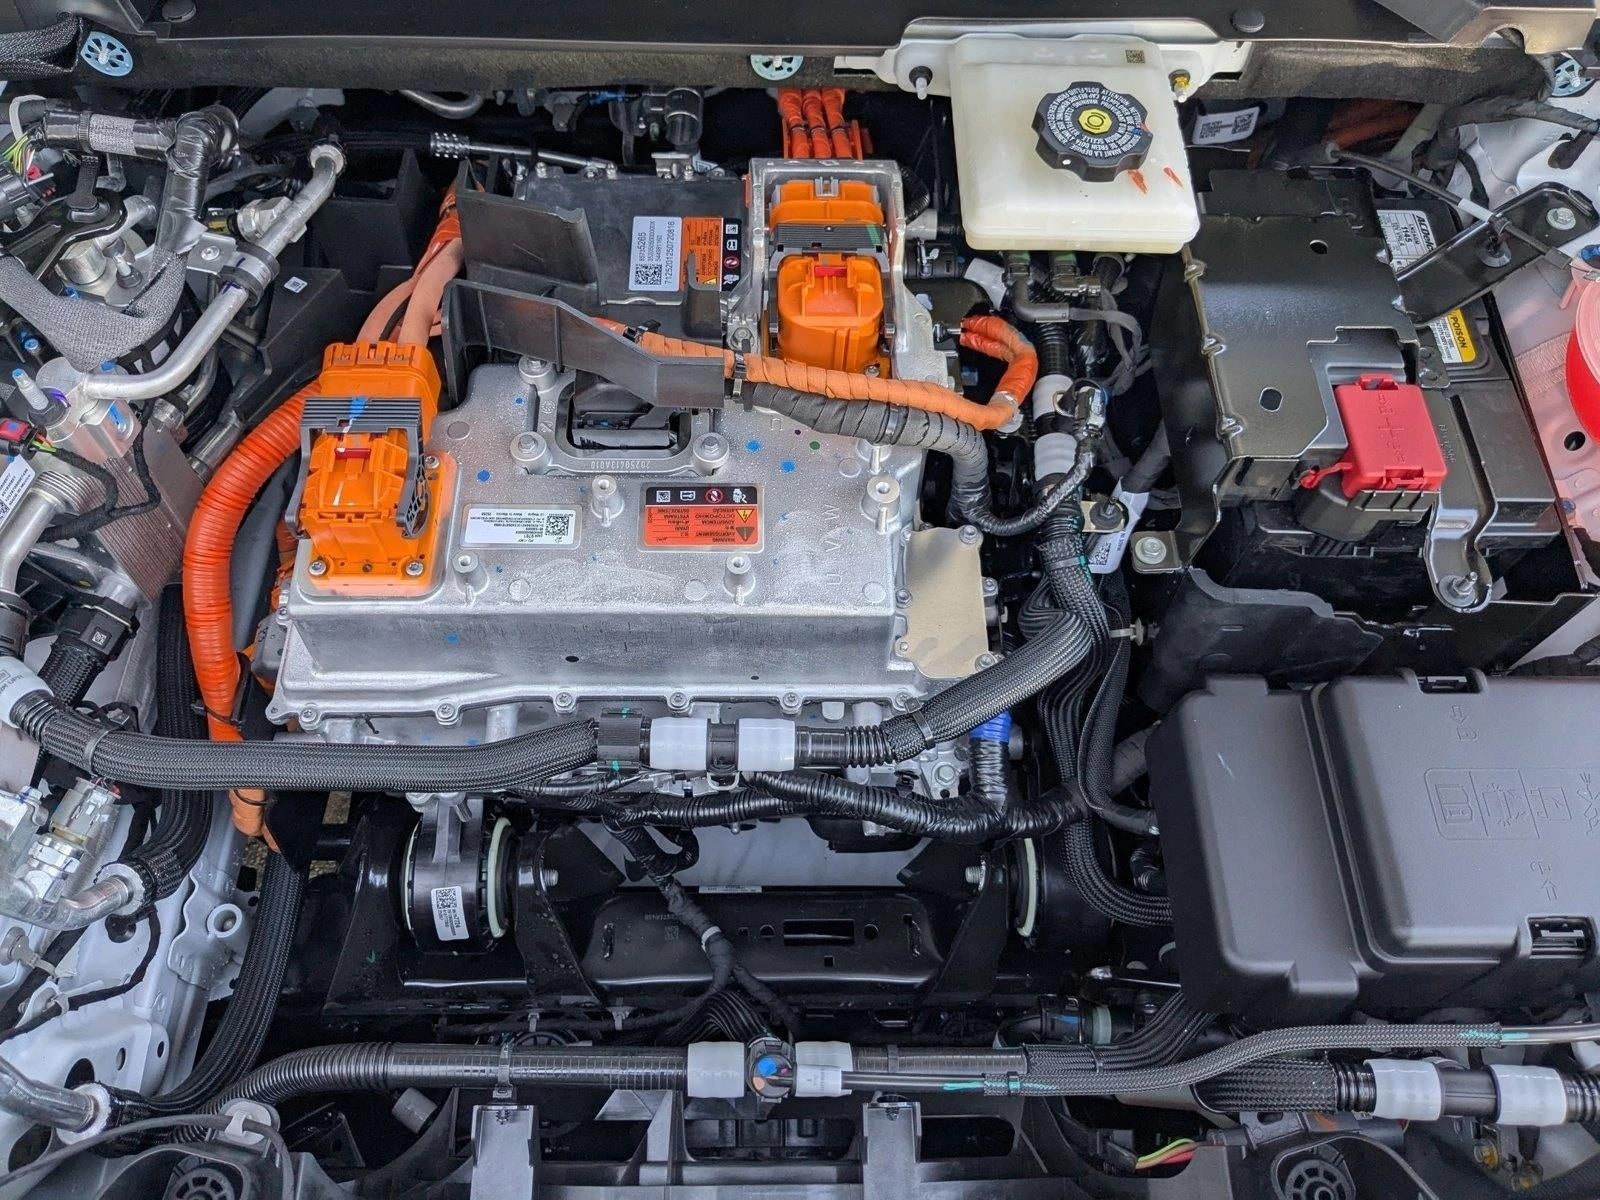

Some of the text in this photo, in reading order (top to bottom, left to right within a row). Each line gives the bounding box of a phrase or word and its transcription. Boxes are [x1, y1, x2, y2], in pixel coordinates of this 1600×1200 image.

[1054, 91, 1070, 104] FROM
[1065, 92, 1088, 103] BEFORE
[1067, 87, 1085, 96] FLUID
[1099, 100, 1126, 122] PROVENANT
[1056, 121, 1067, 131] USE
[1060, 129, 1076, 142] ONLY
[1090, 143, 1110, 151] FREIN
[1108, 141, 1118, 150] DE
[1103, 147, 1124, 158] AVANT
[1401, 226, 1412, 243] 1145
[1416, 215, 1438, 252] ACDelc
[1450, 316, 1468, 349] POISON
[824, 504, 842, 585] U V W
